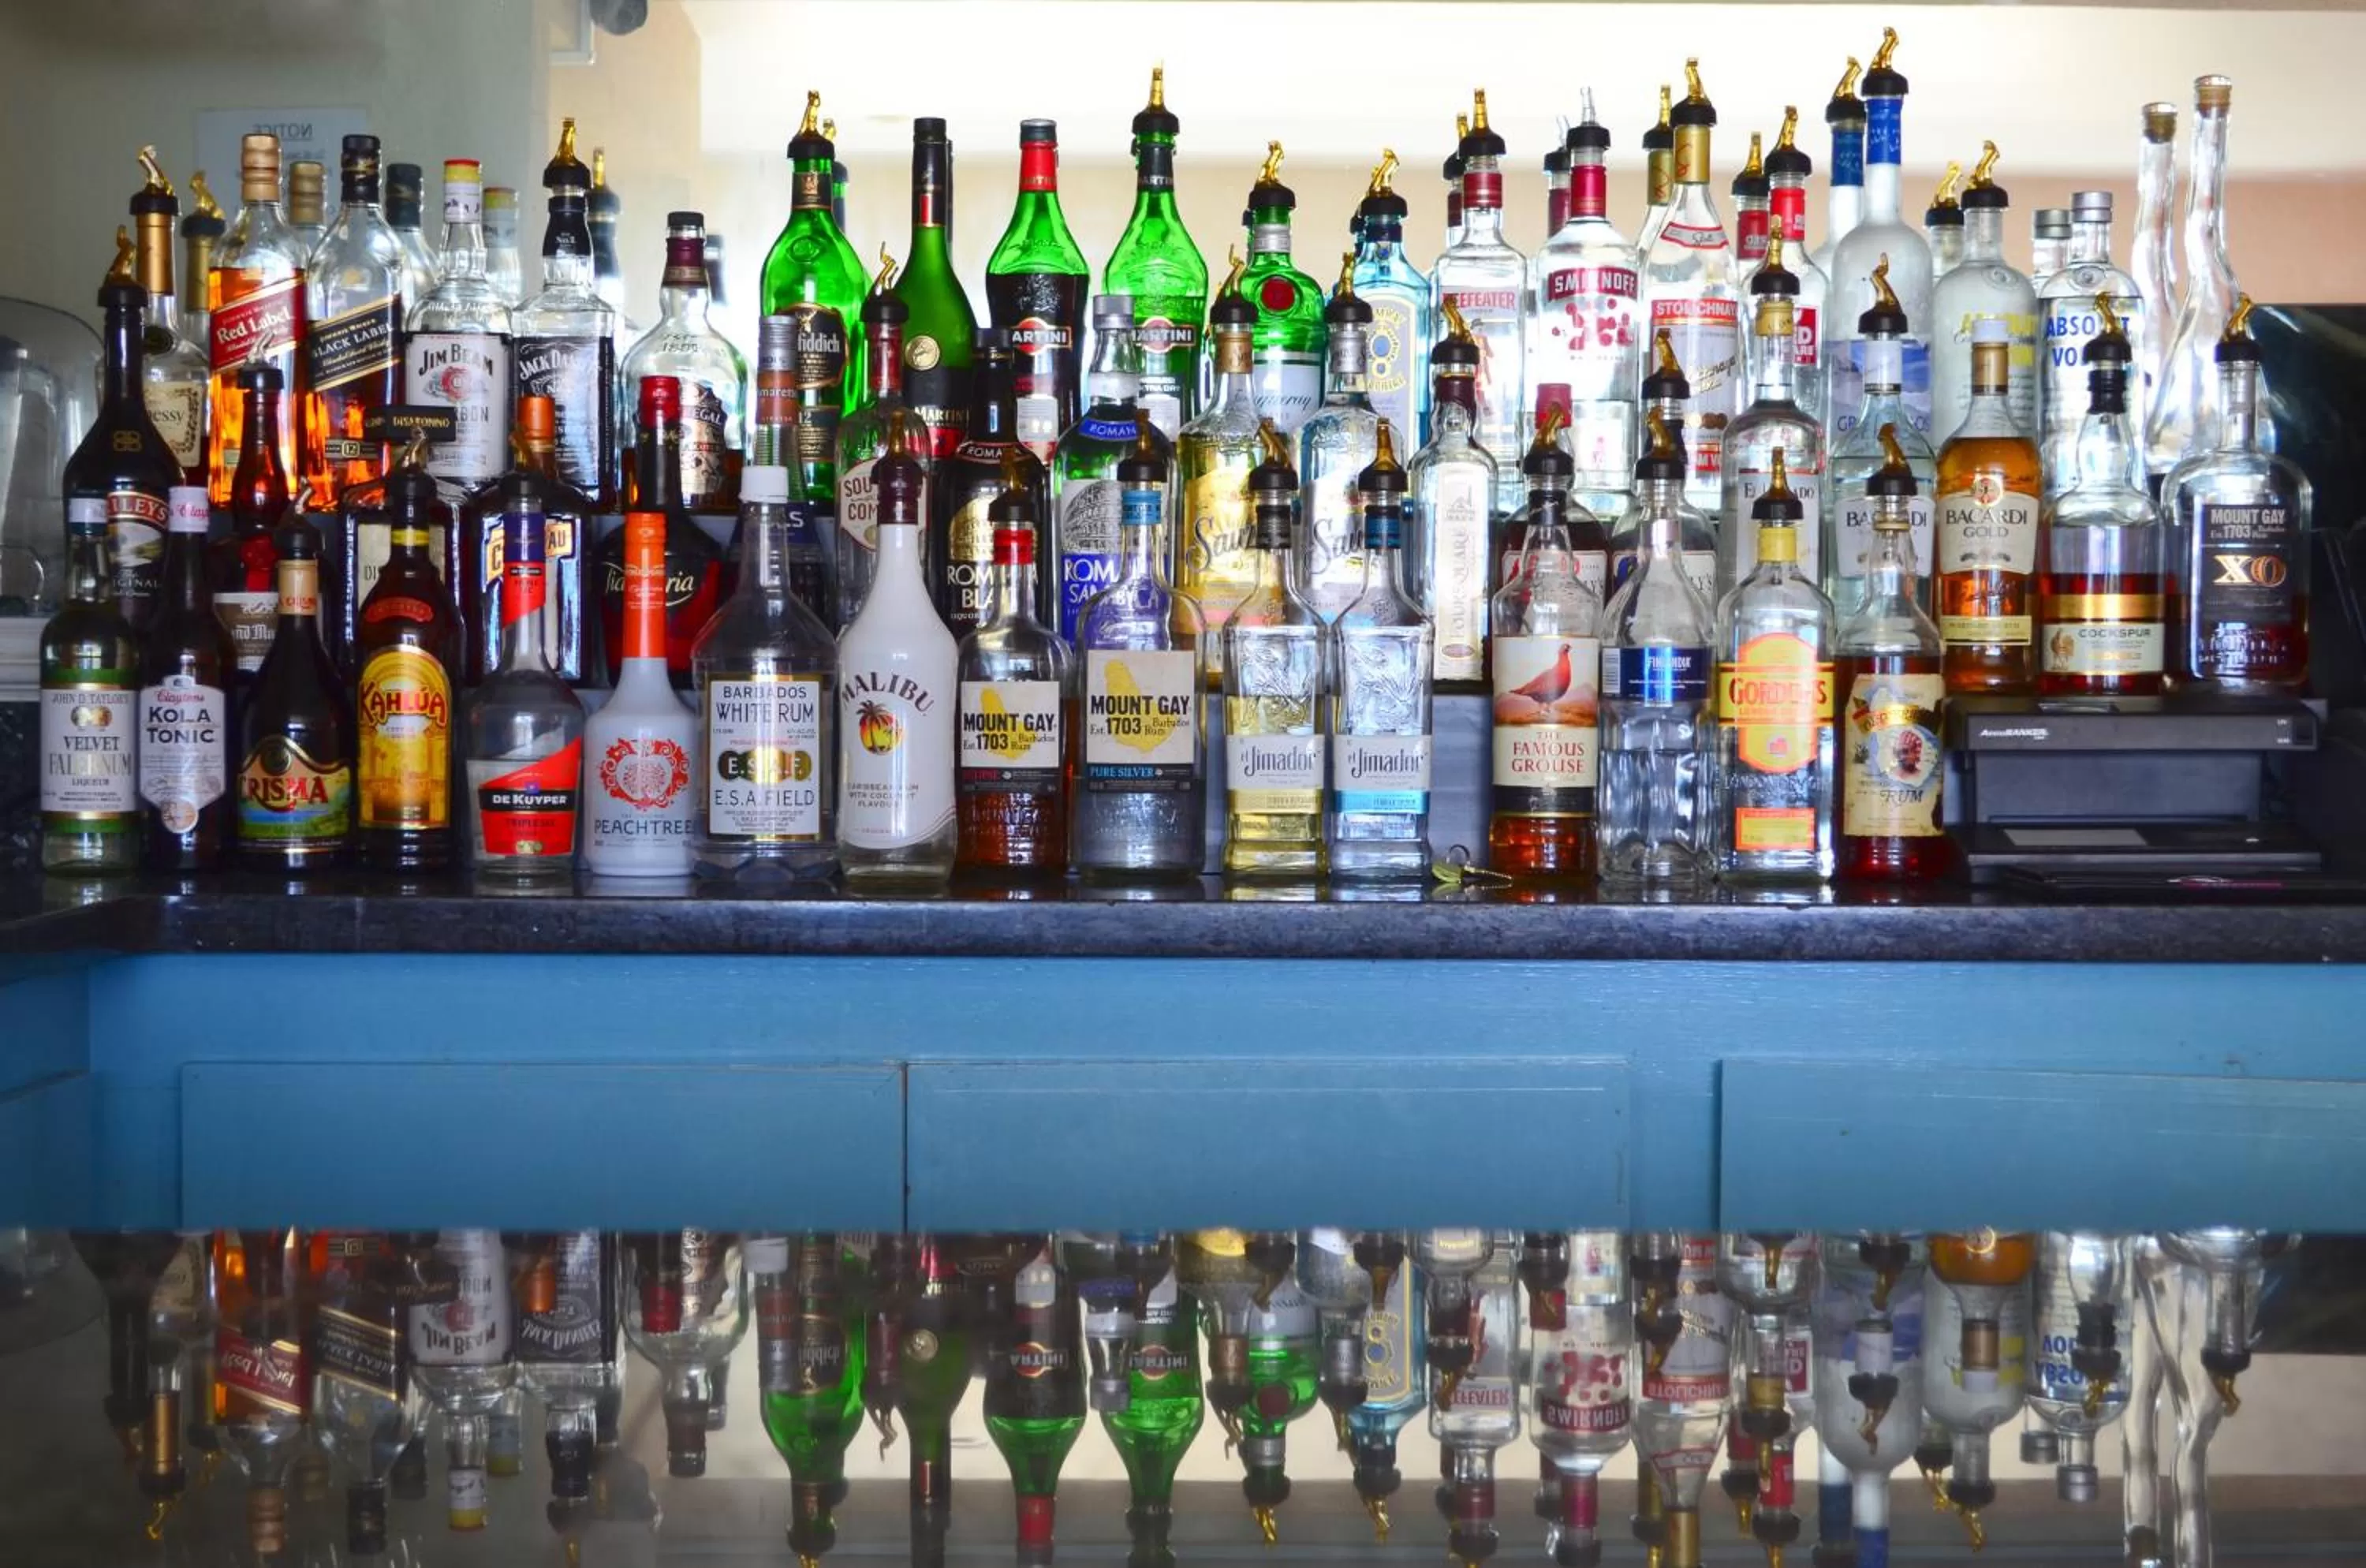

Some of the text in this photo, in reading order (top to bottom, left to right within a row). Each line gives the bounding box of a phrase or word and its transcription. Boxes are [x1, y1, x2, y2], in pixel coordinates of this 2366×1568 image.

[1554, 273, 1636, 293] SMNOFF
[1443, 293, 1515, 308] EFEATER
[217, 323, 248, 342] Red
[248, 307, 295, 334] Label
[354, 323, 394, 343] LABEL
[2046, 316, 2130, 338] ABSOT
[797, 333, 840, 353] fiddich
[1012, 331, 1067, 345] ARTINI
[418, 349, 448, 376] JIM
[519, 360, 550, 381] JACK
[694, 405, 724, 424] EGAL
[345, 442, 356, 454] 12
[966, 444, 1017, 458] ROMA
[109, 497, 168, 522] ILEYS
[1946, 509, 2028, 525] BACARDI
[2211, 509, 2286, 525] MOUNT GAY
[1846, 511, 1928, 528] BADI
[1963, 526, 2009, 537] GOLD
[2222, 525, 2252, 539] 1703
[1309, 517, 1364, 575] Sau
[2212, 554, 2287, 588] XO
[665, 569, 695, 593] ria
[722, 685, 808, 700] BARBADOS
[841, 671, 935, 714] MALIBU
[1728, 677, 1828, 705] GORDS
[359, 681, 449, 727] KAHLÚA
[716, 703, 815, 723] WHITE RUM
[1090, 695, 1192, 715] MOUNT GAY
[148, 706, 211, 724] KOLA
[963, 712, 1055, 733] MOUNT GAY
[1105, 717, 1142, 735] 1703
[1536, 730, 1562, 740] THE
[63, 736, 121, 752] VELVET
[146, 727, 215, 744] TONIC
[976, 733, 1009, 751] 1703
[1513, 741, 1585, 756] FAMOUS
[48, 753, 133, 776] FALNUM
[1118, 766, 1155, 778] SILVER
[1511, 758, 1585, 774] GROUSE
[240, 775, 329, 805] RISMA
[764, 790, 815, 807] FIELD
[1880, 788, 1924, 805] RUM
[492, 793, 567, 806] DE KUYPER
[593, 819, 695, 835] PEACHTREE
